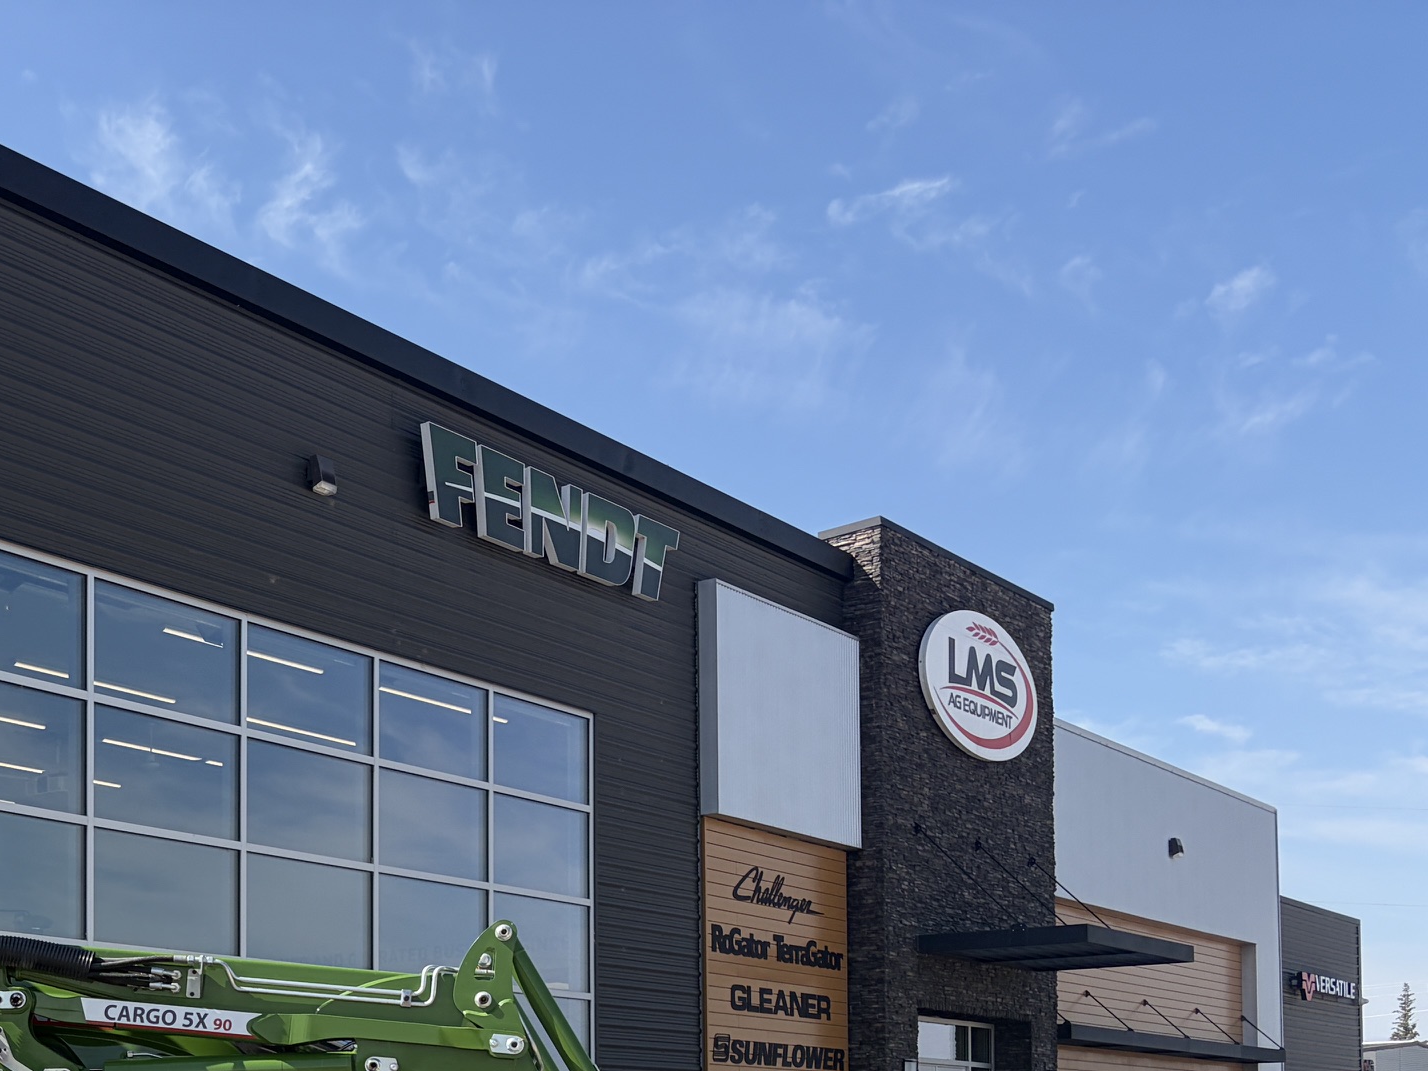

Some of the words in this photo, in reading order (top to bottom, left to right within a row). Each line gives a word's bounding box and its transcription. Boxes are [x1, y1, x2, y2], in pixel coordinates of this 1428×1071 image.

[420, 421, 679, 601] FENDT
[948, 636, 1018, 709] LMS
[948, 693, 962, 709] AG
[963, 698, 1014, 730] EQUIPMENT
[732, 866, 824, 924] Challenger
[711, 924, 770, 960] RoGator
[773, 935, 843, 971] TerraGator
[730, 984, 831, 1021] GLEANER
[1316, 975, 1356, 999] VERSATILE
[104, 1004, 177, 1027] CARGO
[182, 1011, 209, 1030] 5X
[213, 1018, 232, 1032] 90
[730, 1038, 845, 1071] SUNFLOWER
